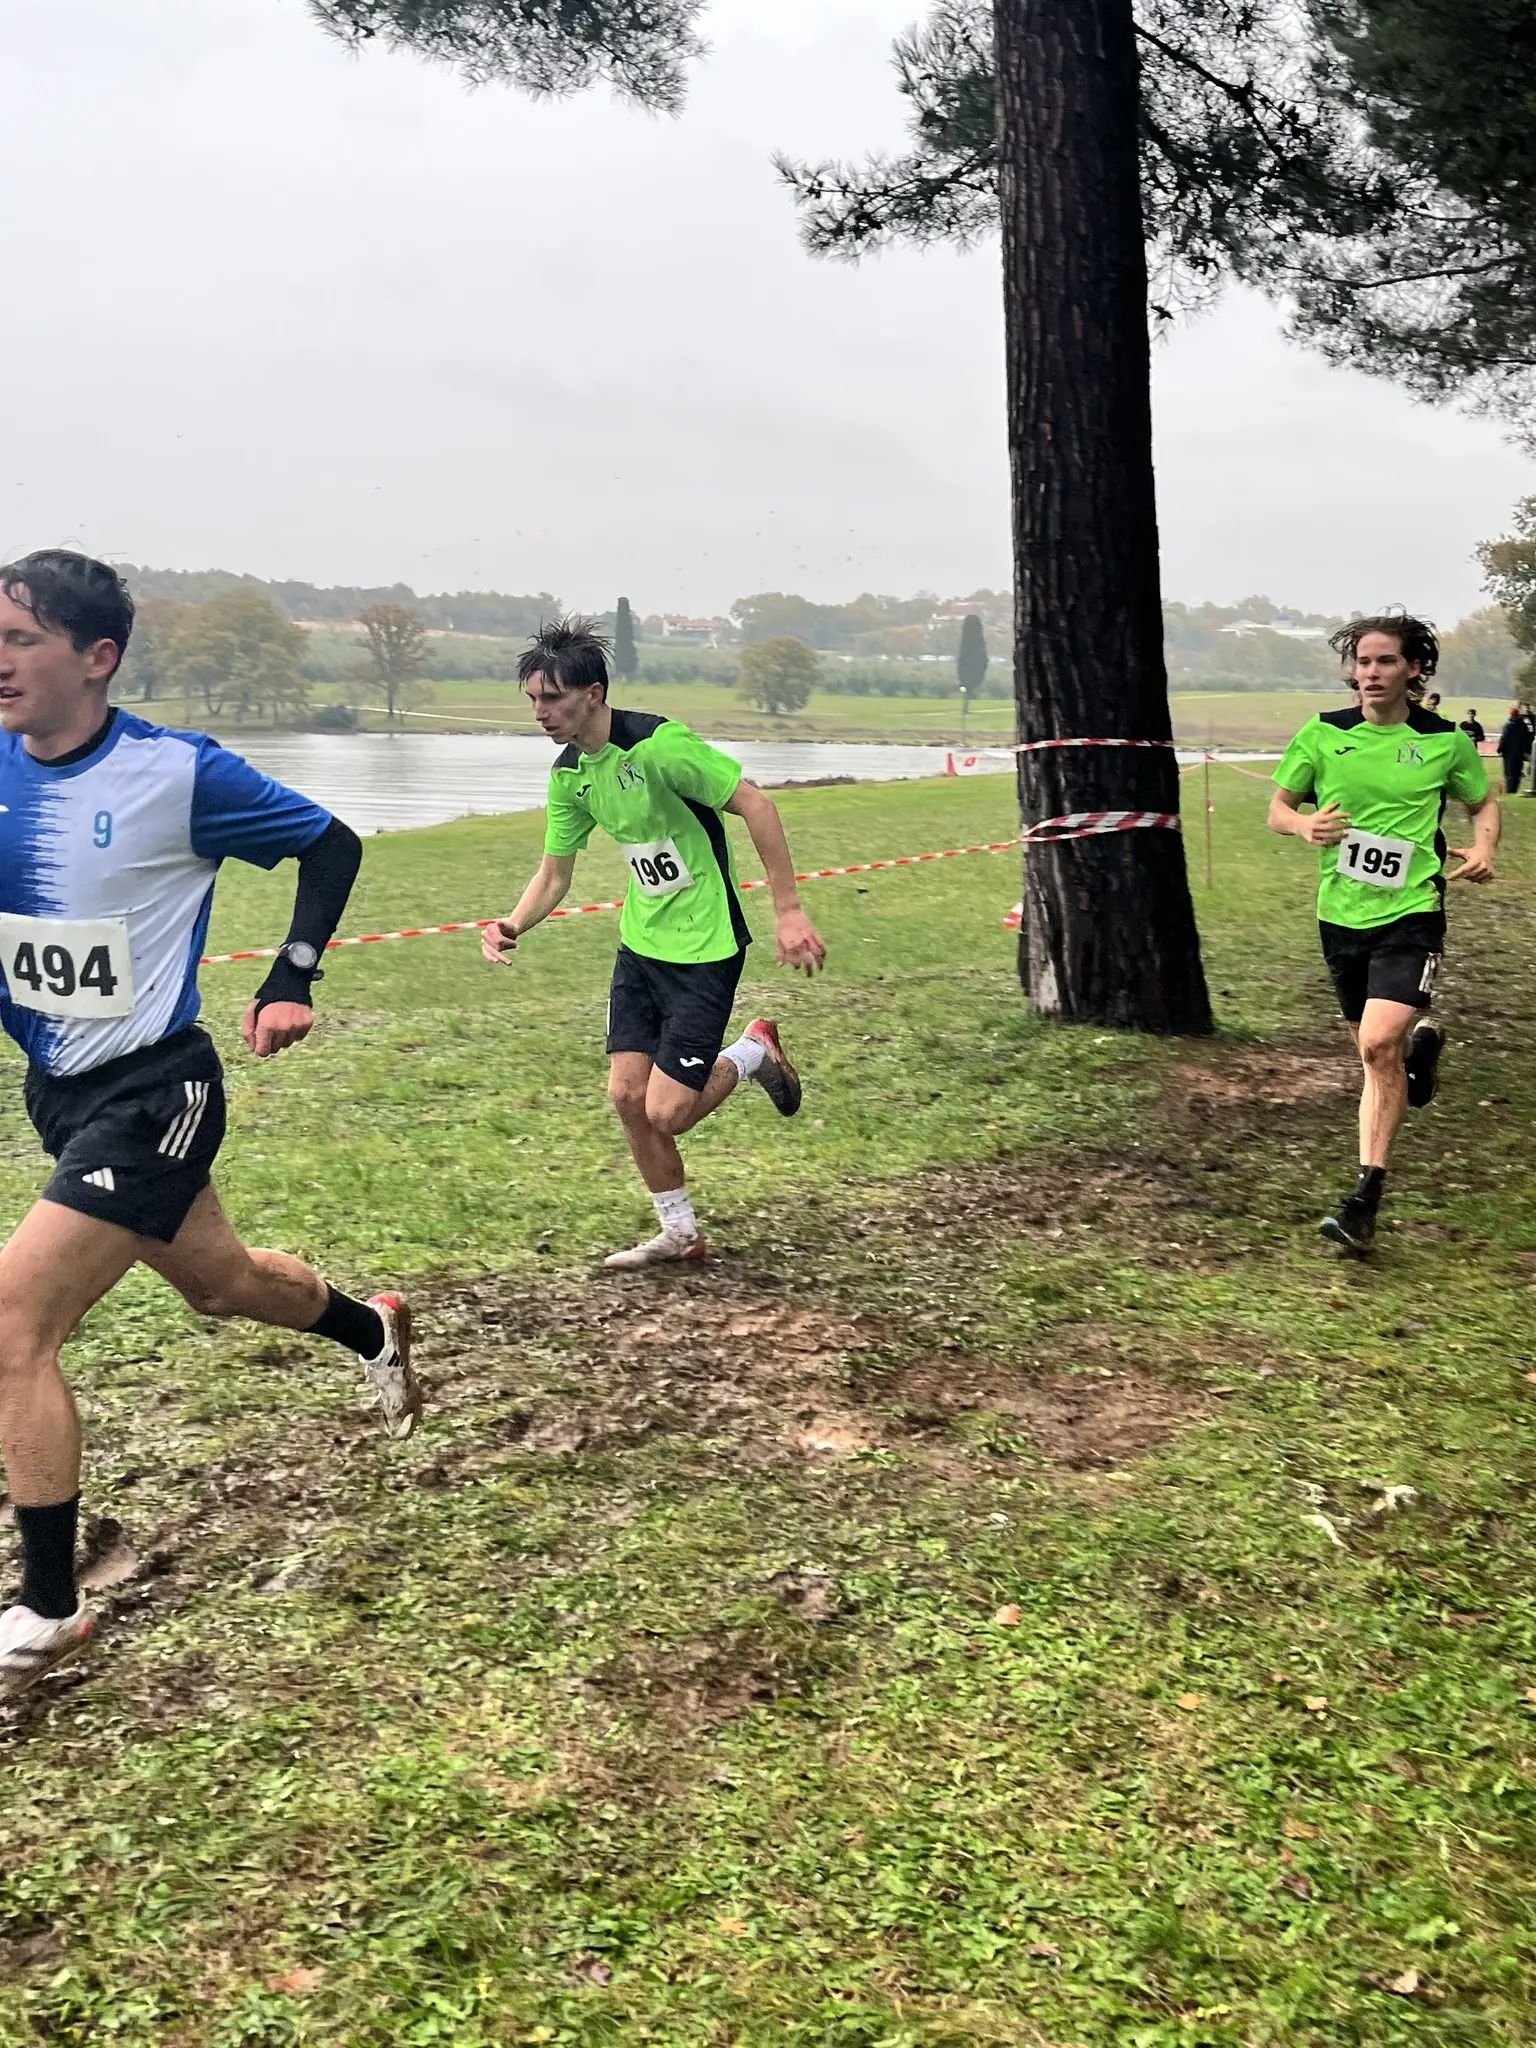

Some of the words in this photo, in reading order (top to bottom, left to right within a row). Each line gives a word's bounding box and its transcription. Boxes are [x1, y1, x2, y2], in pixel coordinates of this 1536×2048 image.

[93, 810, 112, 848] 9
[631, 852, 680, 886] 196
[1348, 842, 1402, 878] 195
[13, 942, 118, 996] 494
